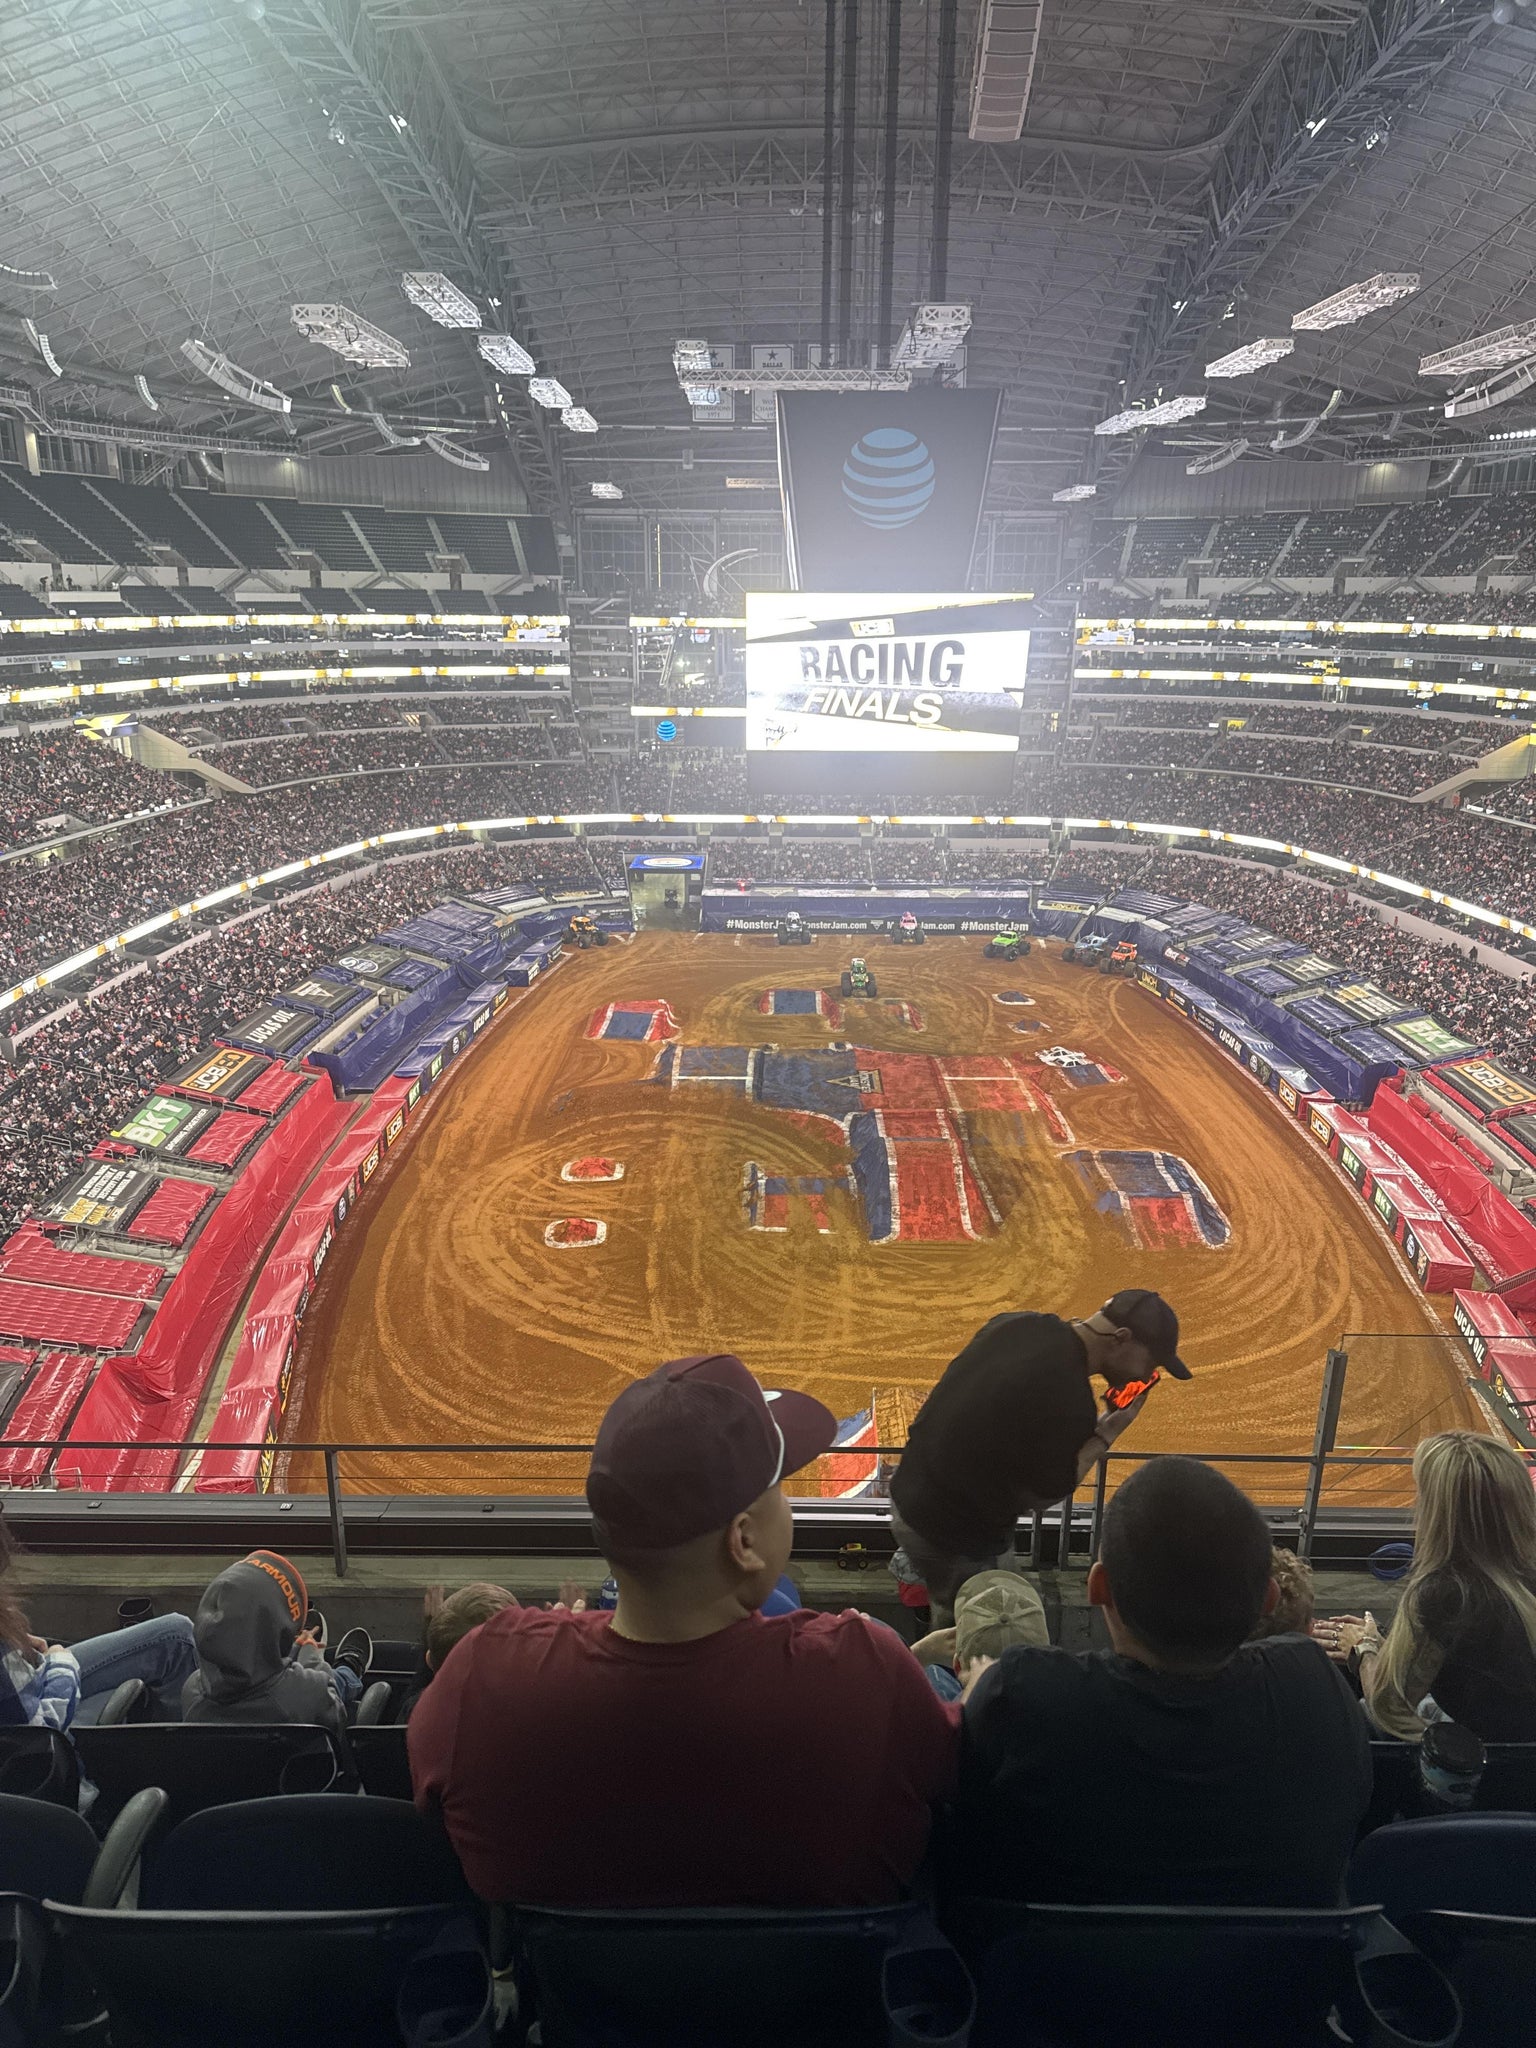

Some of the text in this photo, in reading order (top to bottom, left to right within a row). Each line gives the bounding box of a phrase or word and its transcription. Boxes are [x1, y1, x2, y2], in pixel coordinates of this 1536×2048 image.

[799, 640, 965, 687] RACING
[802, 686, 943, 725] FINALS
[726, 919, 784, 930] #MonsterJ
[960, 920, 1029, 932] #MonsterJam
[245, 1009, 299, 1044] LUCAS OIL
[187, 1066, 228, 1090] JCB
[1463, 1064, 1506, 1090] JCB
[1280, 1084, 1296, 1106] JCB
[123, 1098, 184, 1145] BKT
[388, 1114, 403, 1140] JCB
[1312, 1116, 1331, 1140] JCB
[364, 1151, 379, 1177] JCB
[1342, 1146, 1360, 1172] BKT
[1374, 1186, 1392, 1215] BKT
[1454, 1304, 1486, 1367] LUCAS OIL
[247, 1559, 300, 1622] ARMOUR
